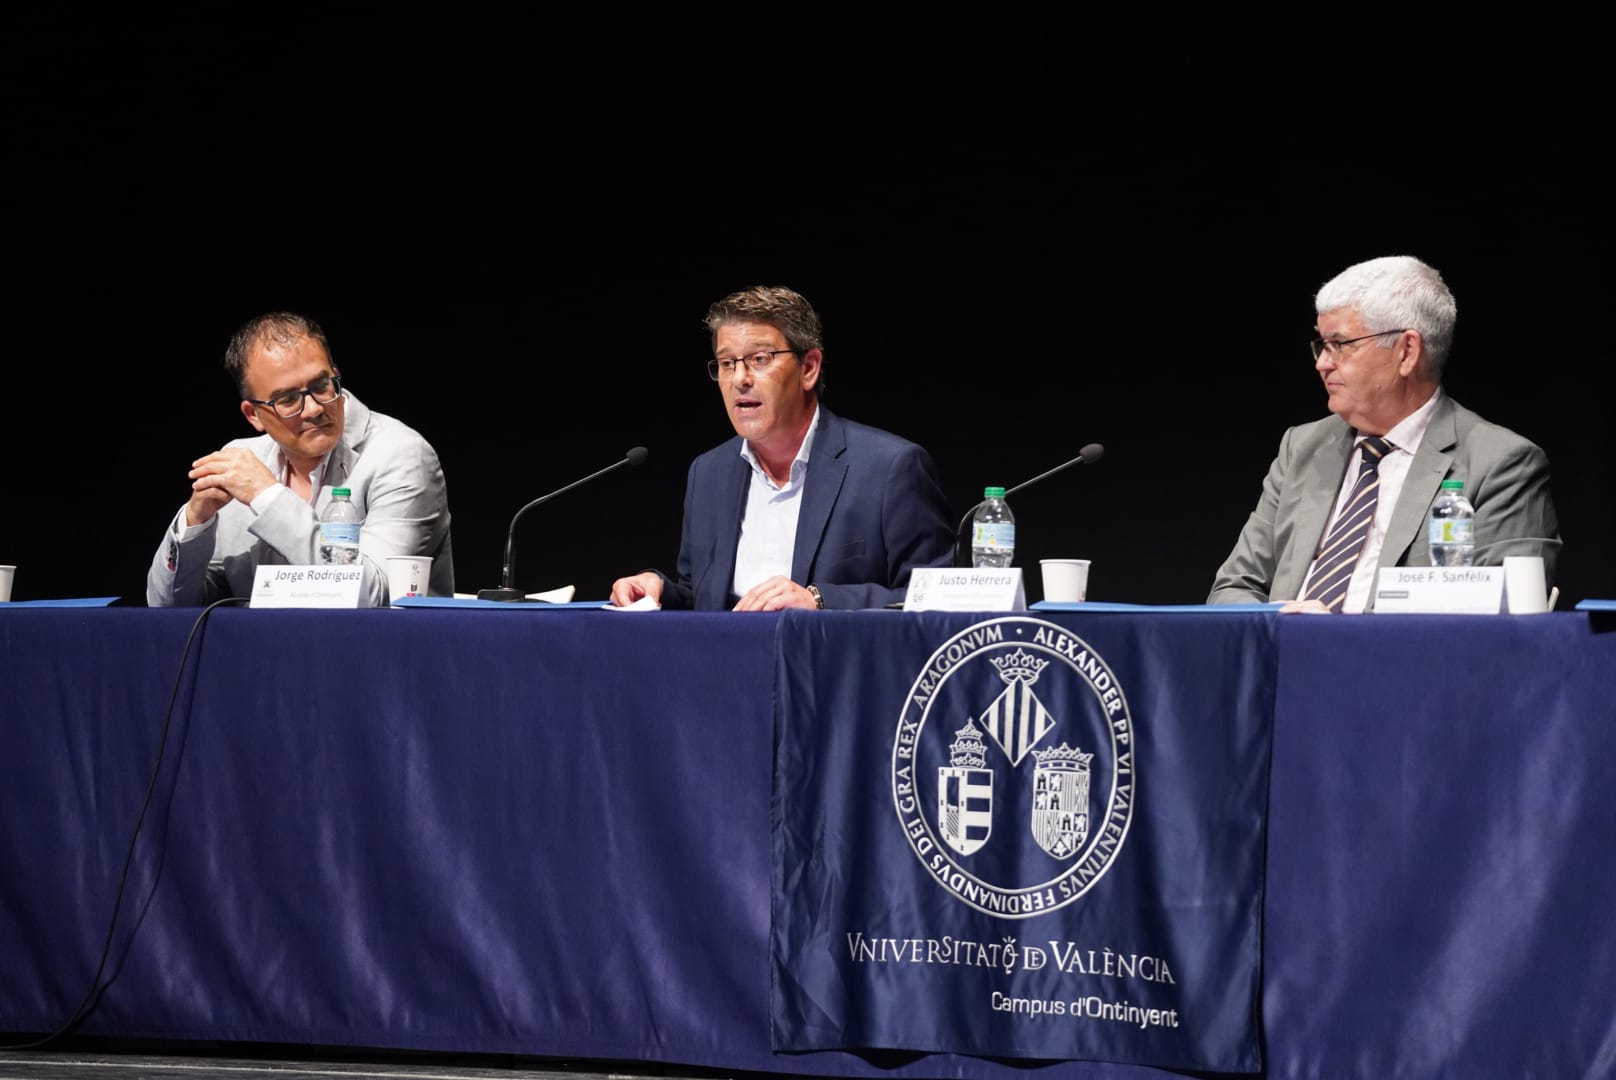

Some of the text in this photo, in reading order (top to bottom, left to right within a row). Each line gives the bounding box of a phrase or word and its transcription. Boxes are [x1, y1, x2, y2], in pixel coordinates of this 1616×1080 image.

[275, 570, 304, 582] Jorge
[940, 575, 1012, 585] Justo Herrera
[1428, 571, 1438, 582] F.
[897, 625, 1131, 913] ALEXANDER PP VI VALENTINVS FERDINANDVS DEI GRA REX ARAGONVM
[991, 992, 1179, 1029] Campus d'Ontinyent
